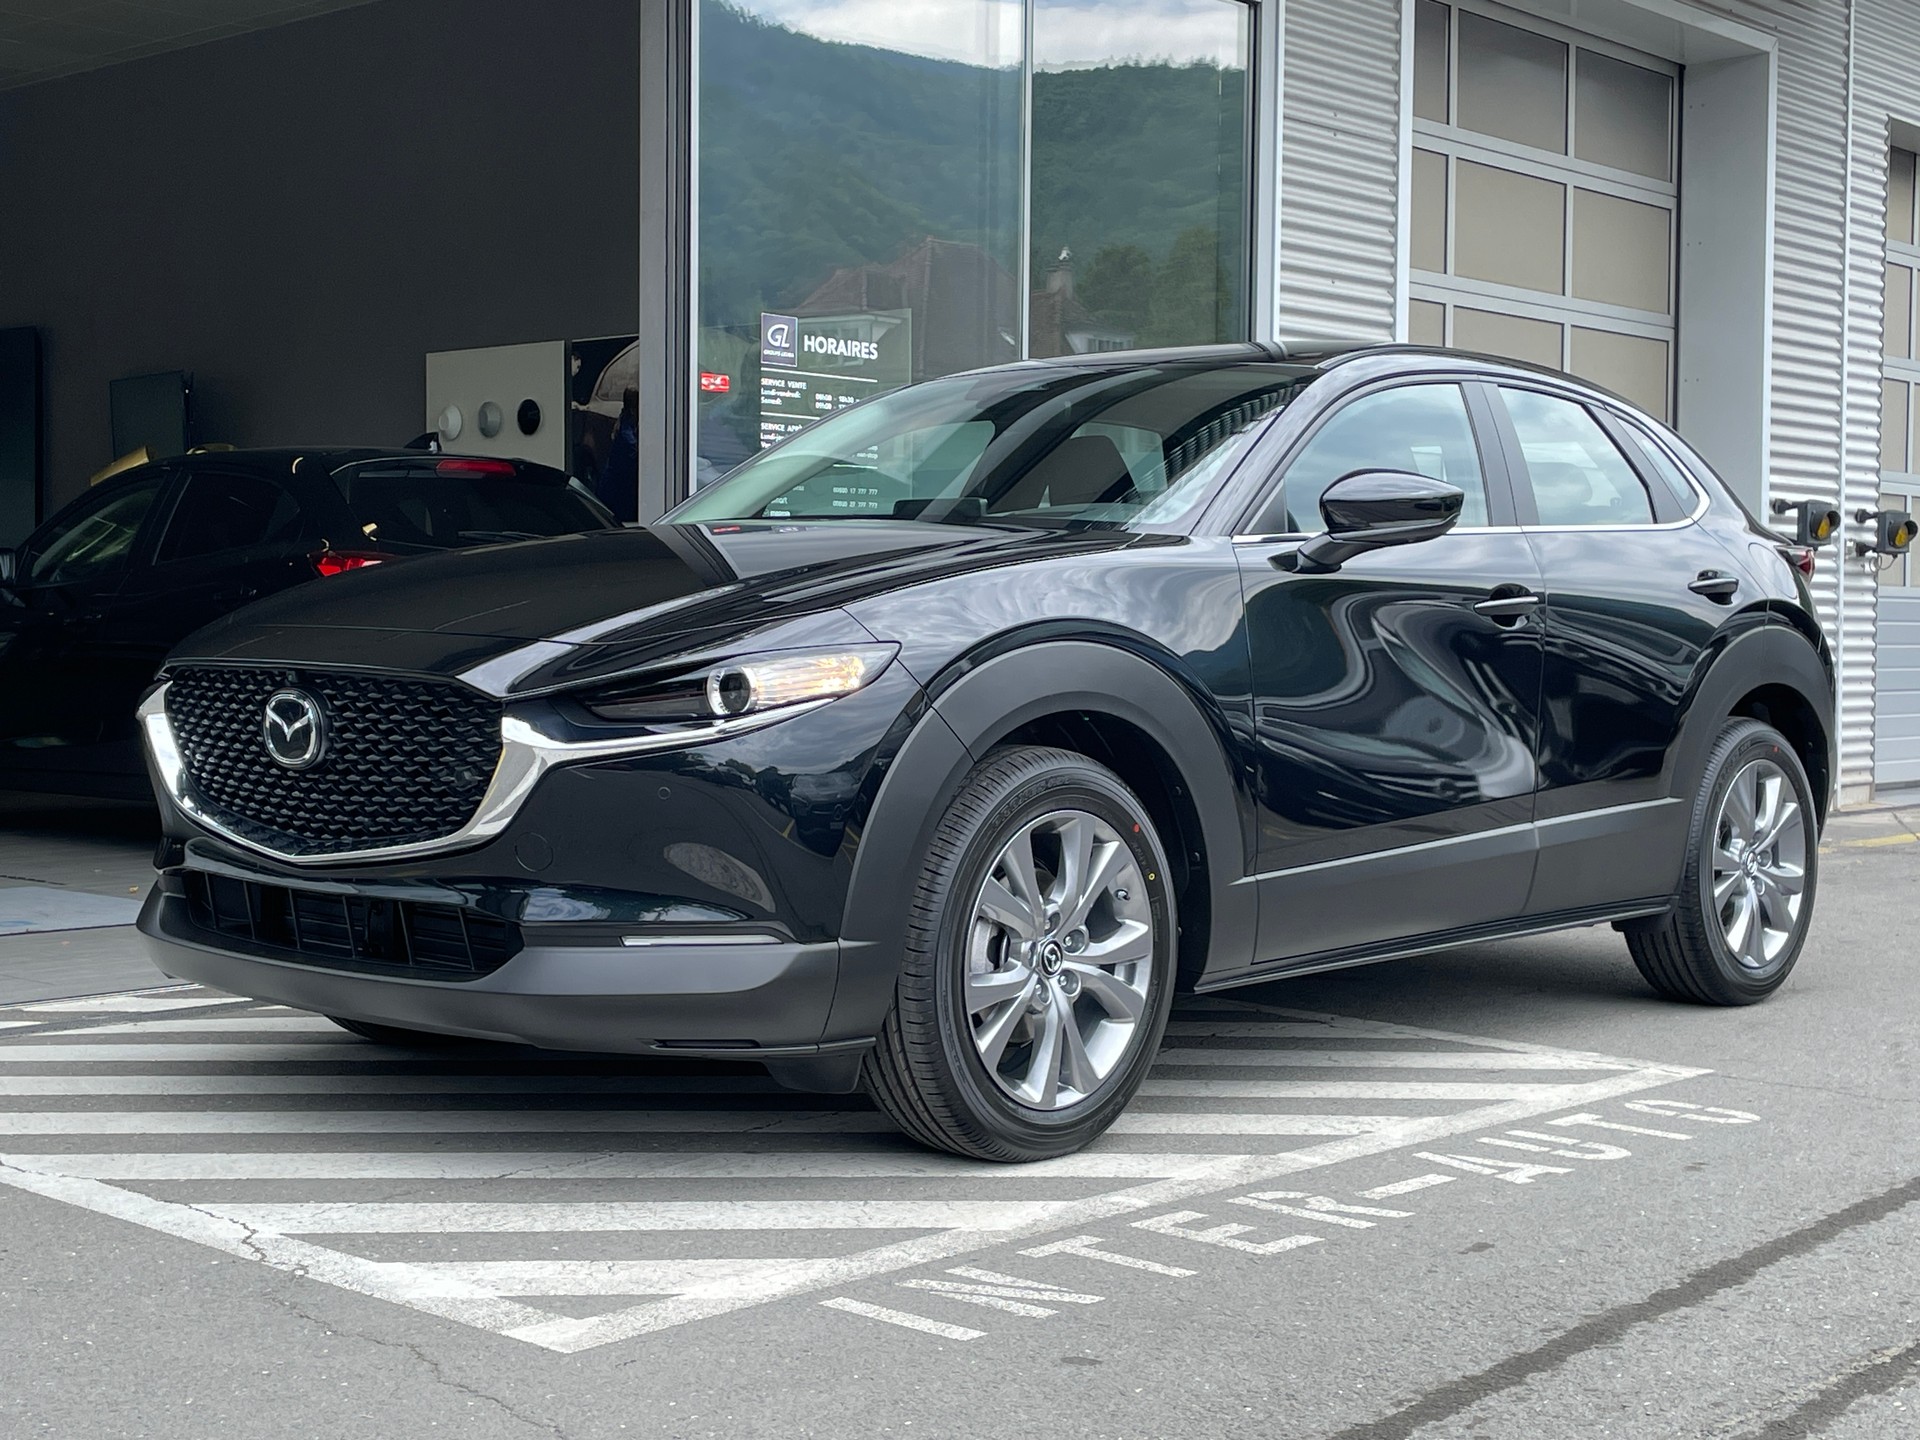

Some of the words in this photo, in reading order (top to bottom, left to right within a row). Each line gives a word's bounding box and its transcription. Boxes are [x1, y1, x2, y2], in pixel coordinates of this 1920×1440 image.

[767, 323, 790, 348] GL
[803, 334, 879, 360] HORAIRES
[760, 377, 785, 387] SERVICE
[787, 380, 807, 390] VENTE
[760, 422, 785, 432] SERVICE
